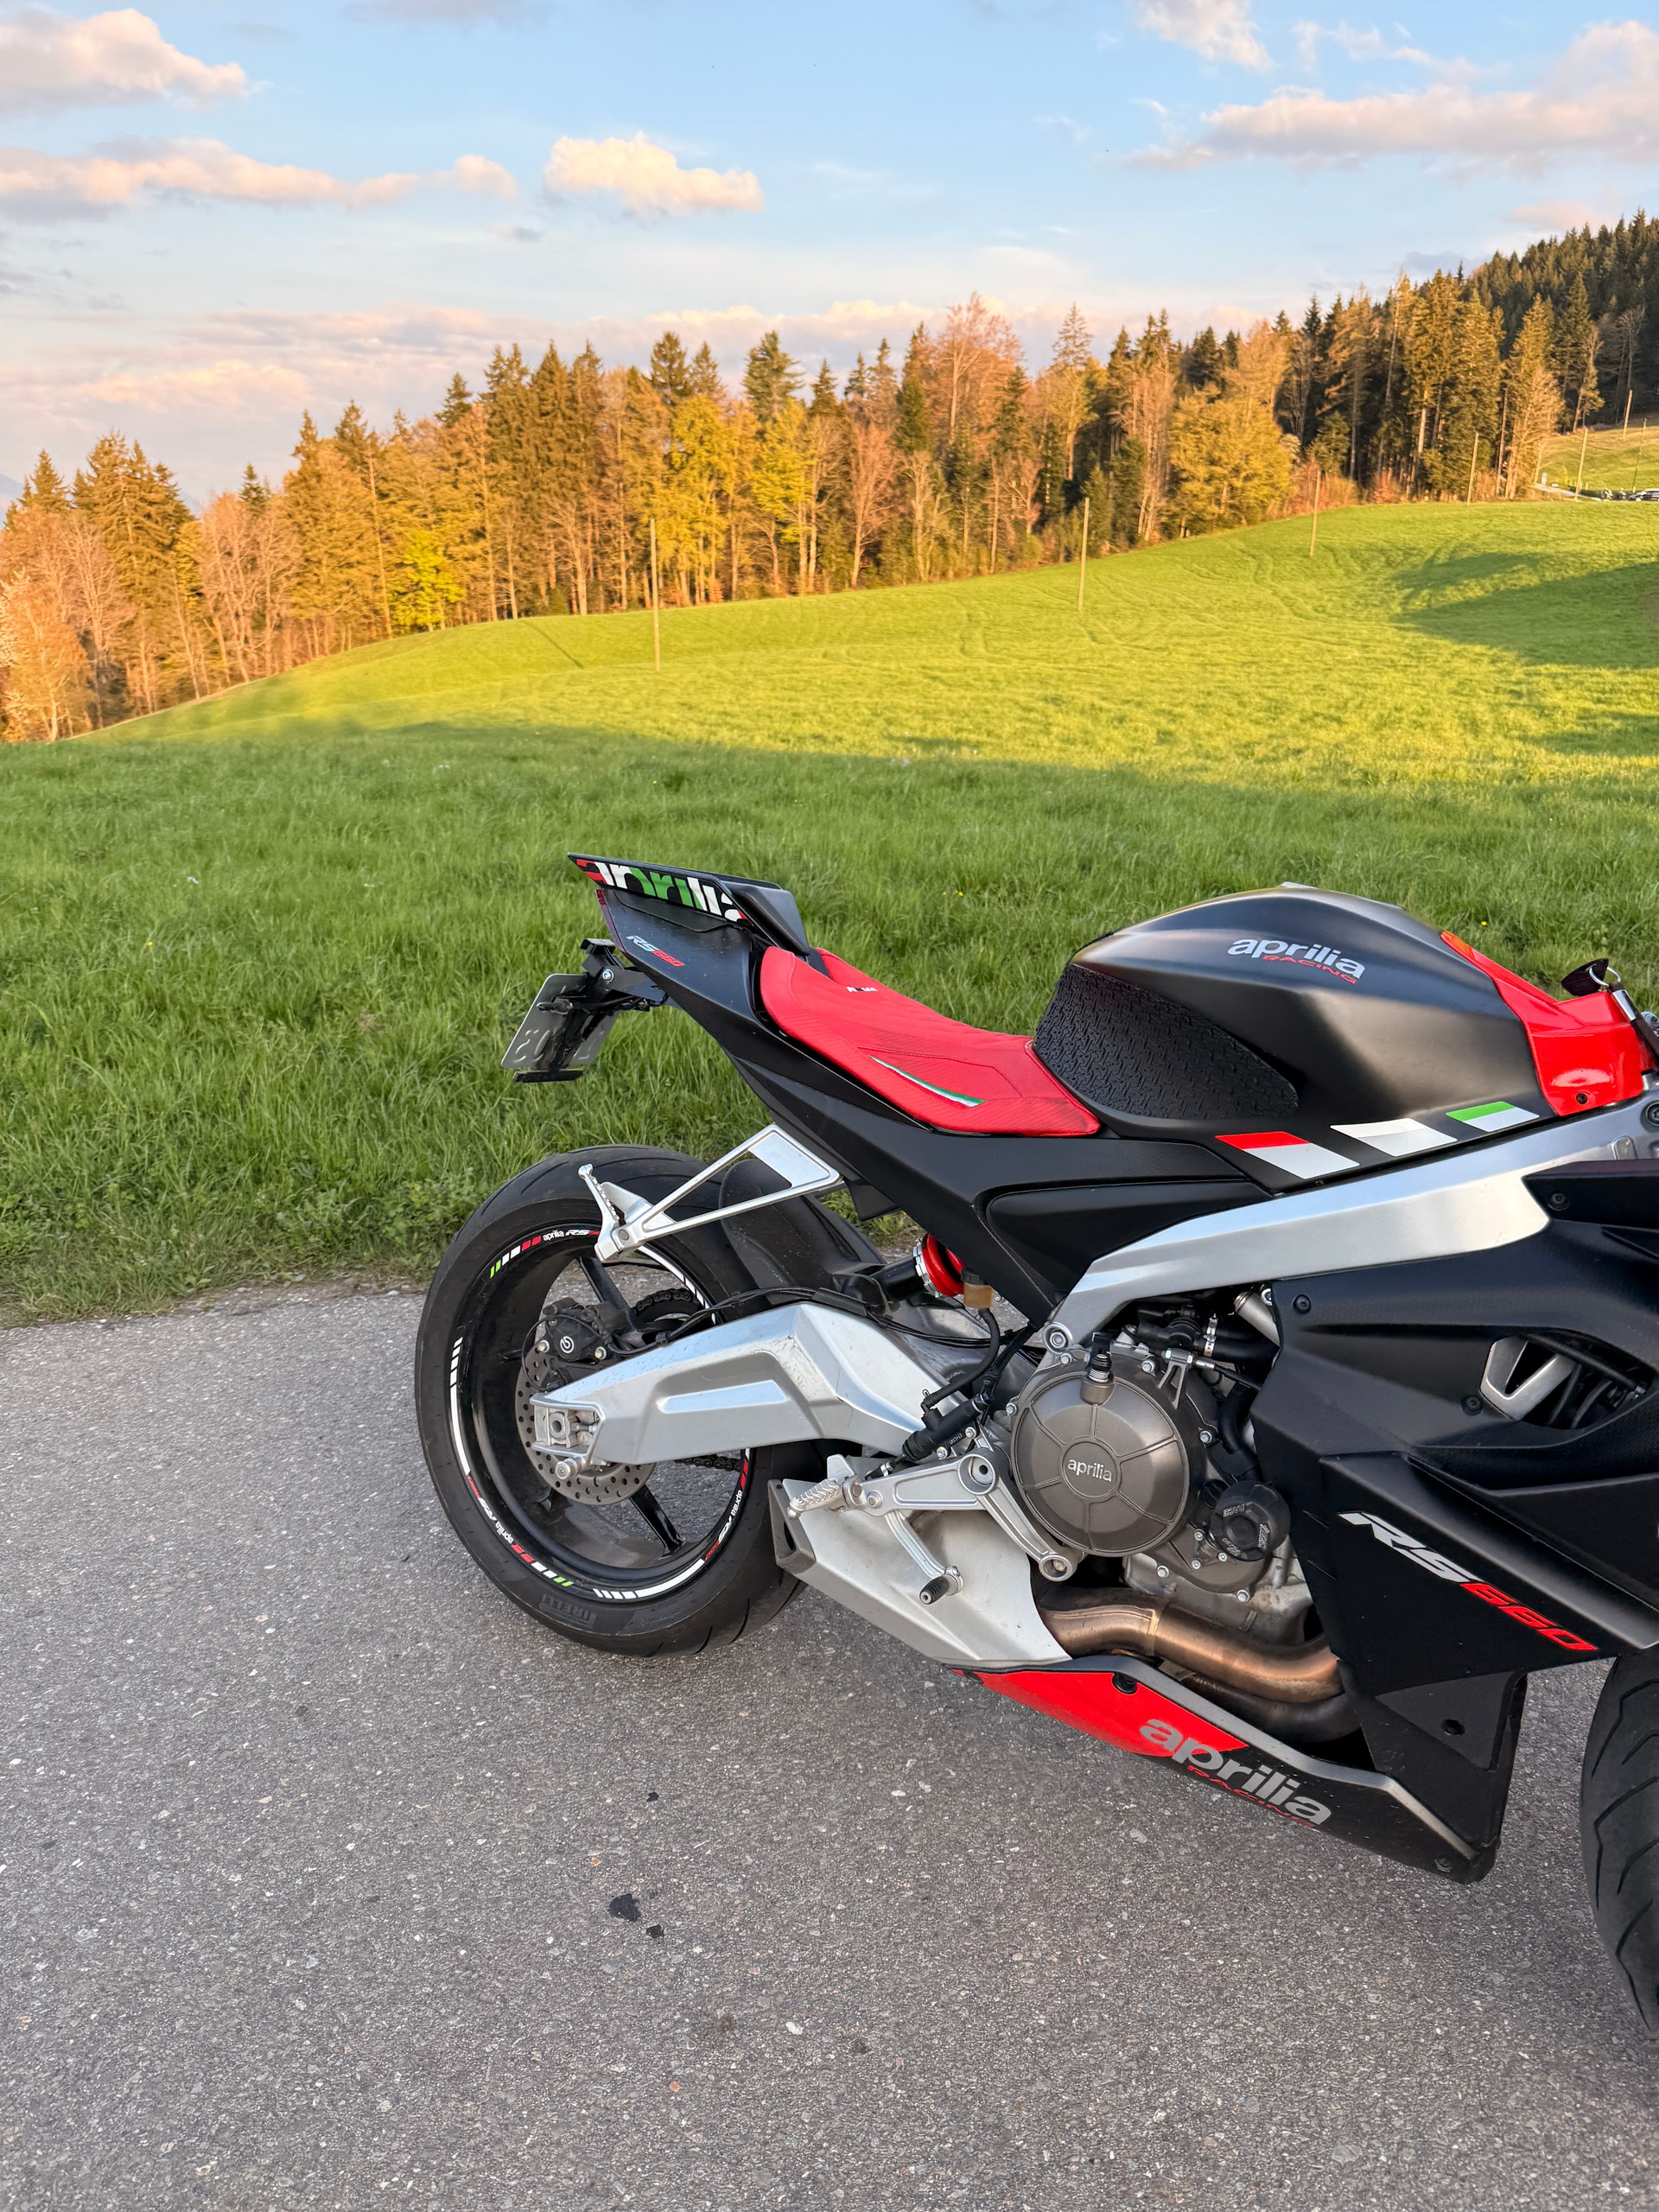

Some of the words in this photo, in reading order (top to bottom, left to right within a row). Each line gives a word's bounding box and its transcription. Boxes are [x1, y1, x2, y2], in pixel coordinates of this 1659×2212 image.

[626, 935, 685, 968] RS660
[1227, 938, 1366, 979] aprilia
[1262, 955, 1357, 985] RACING
[543, 1229, 565, 1242] aprilia
[1067, 1459, 1113, 1483] aprilia
[495, 1521, 514, 1544] aprilia
[1338, 1511, 1599, 1651] RS660
[537, 1592, 597, 1630] PIRELLI
[1139, 1719, 1332, 1825] aprilia
